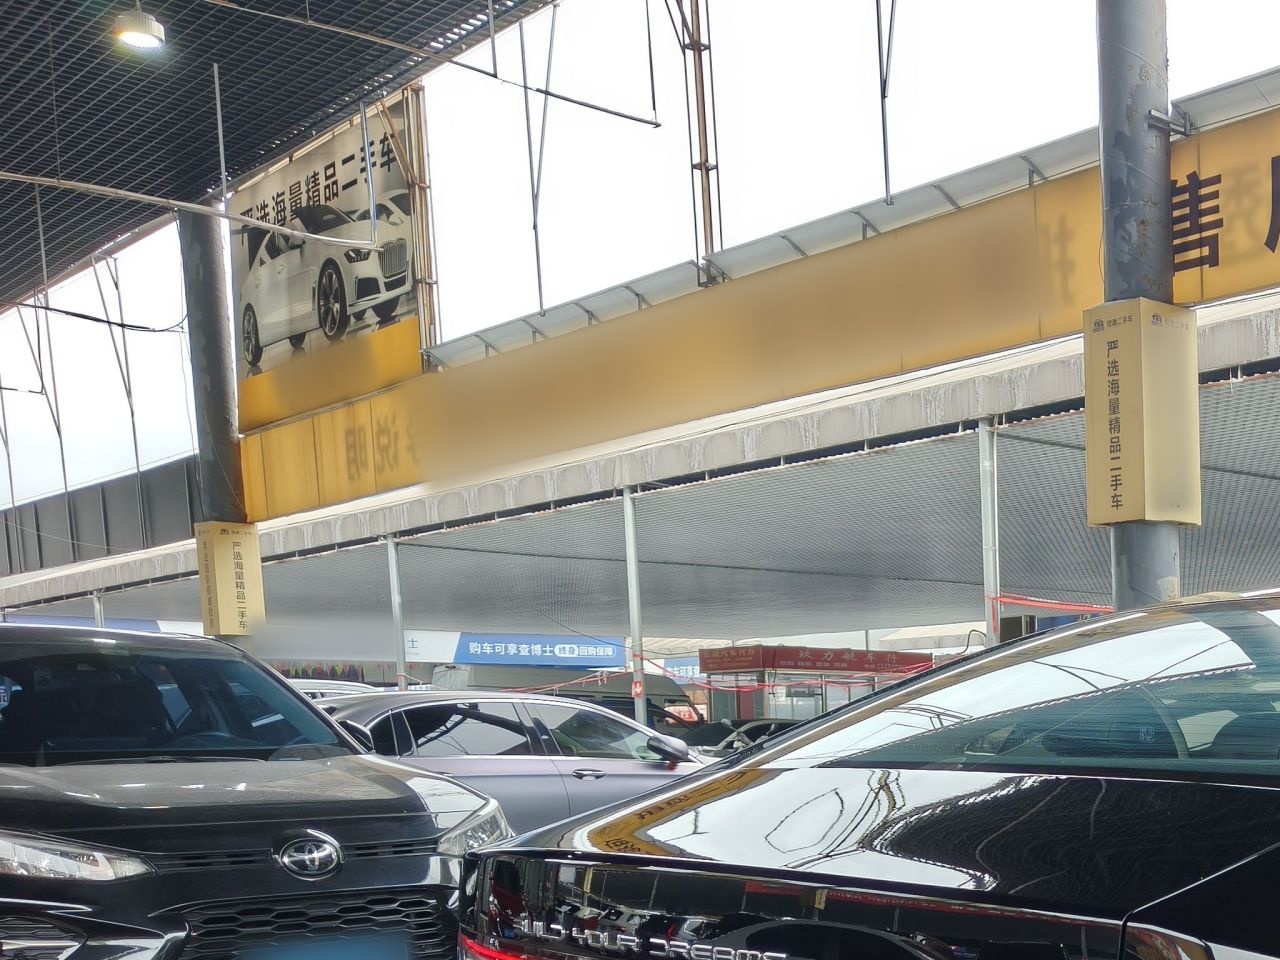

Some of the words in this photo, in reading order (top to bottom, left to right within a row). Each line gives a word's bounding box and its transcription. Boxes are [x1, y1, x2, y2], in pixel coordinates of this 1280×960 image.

[1106, 339, 1123, 510] 严选海量精品二手车
[232, 541, 248, 630] 严选海量精品二手车
[469, 641, 553, 657] 购车可享查博士
